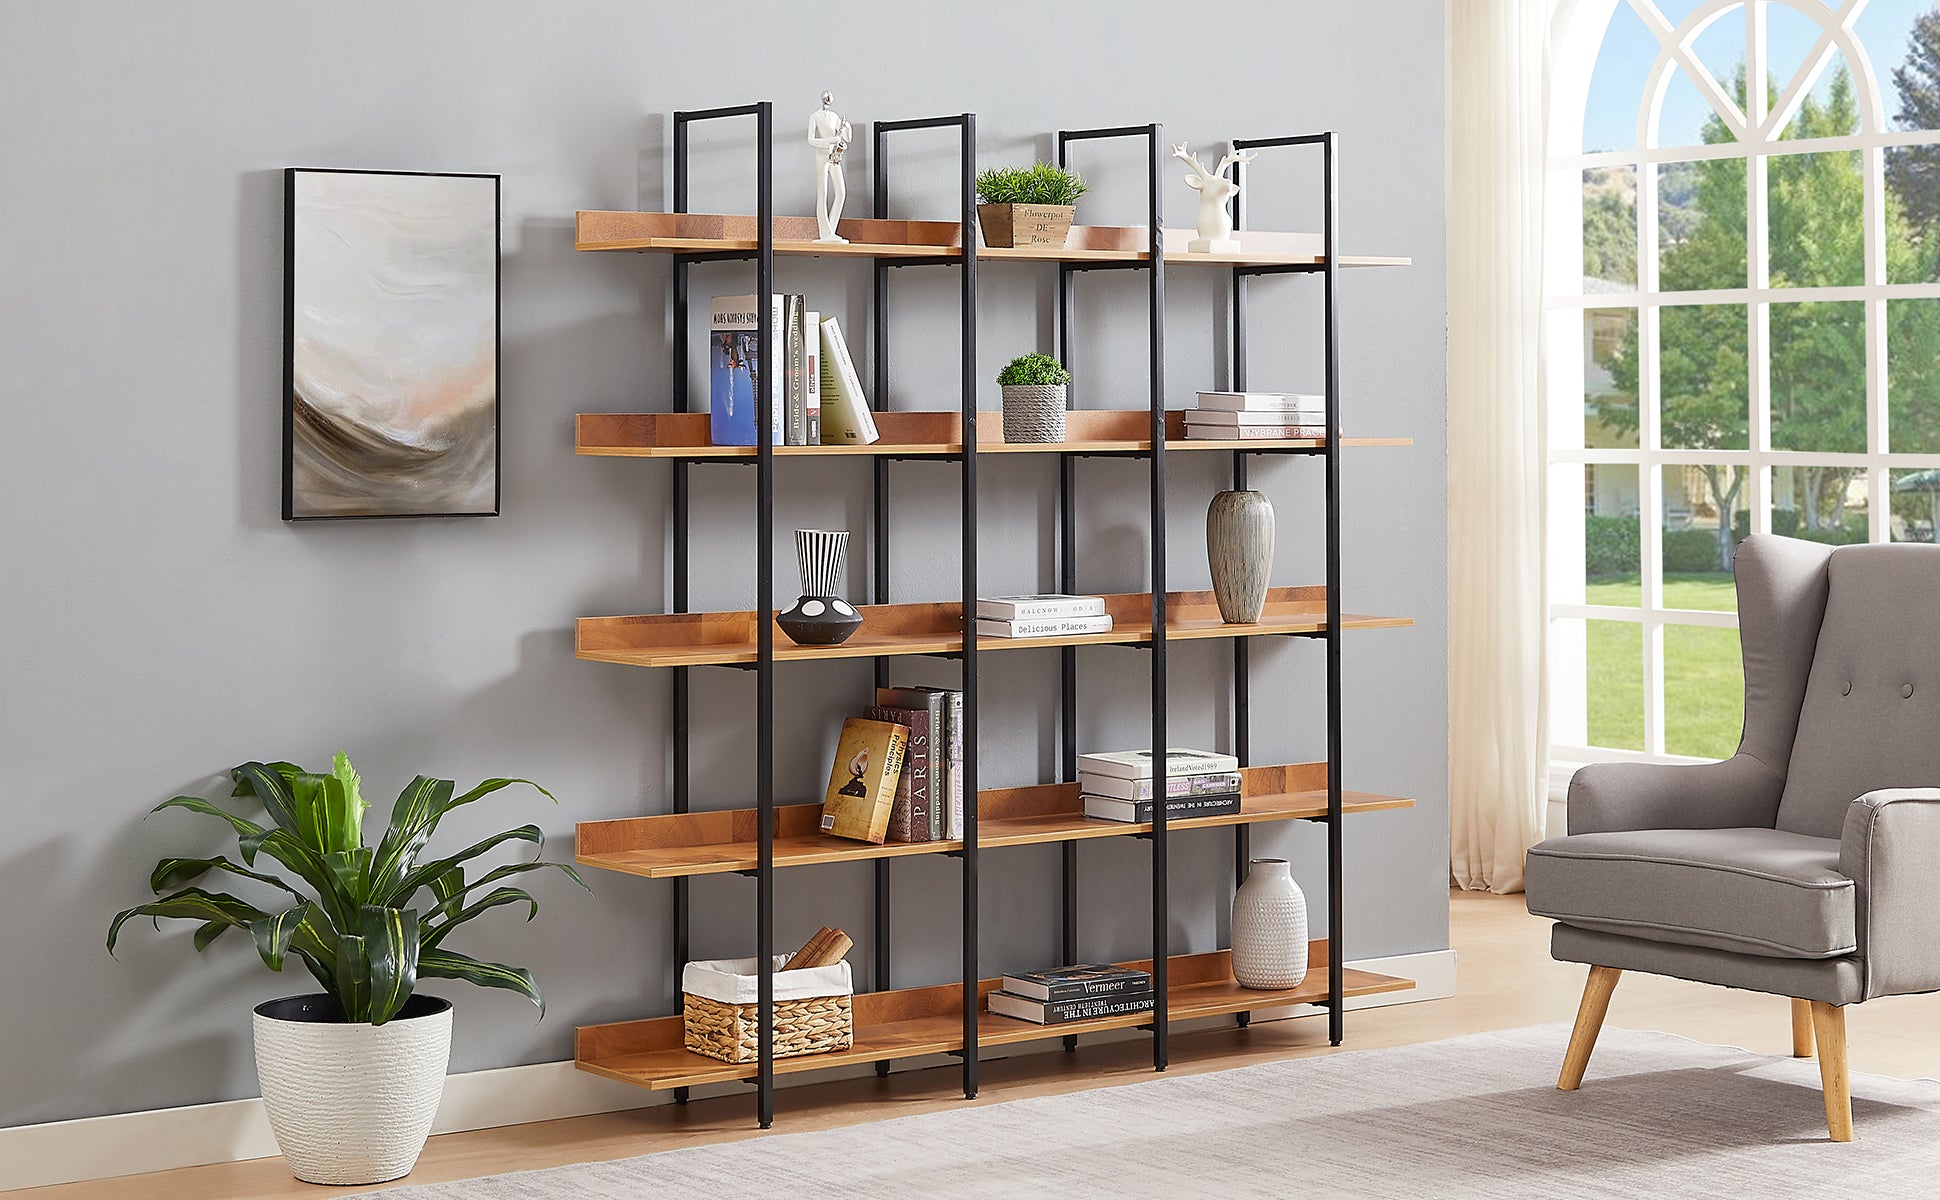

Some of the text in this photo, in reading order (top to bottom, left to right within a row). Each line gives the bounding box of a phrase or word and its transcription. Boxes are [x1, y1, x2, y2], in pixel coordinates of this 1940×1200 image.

[1024, 209, 1063, 220] Flowerpot
[1036, 223, 1048, 232] DE
[1031, 235, 1050, 243] Rose
[1018, 624, 1058, 633] Delicious
[1061, 623, 1088, 631] Places
[871, 708, 902, 722] PARIS
[884, 734, 900, 777] Principles
[893, 740, 906, 775] Physics
[913, 735, 927, 817] PARIS
[1083, 981, 1125, 994] Vermeer
[1063, 1010, 1081, 1019] THE
[1081, 1008, 1092, 1017] IN
